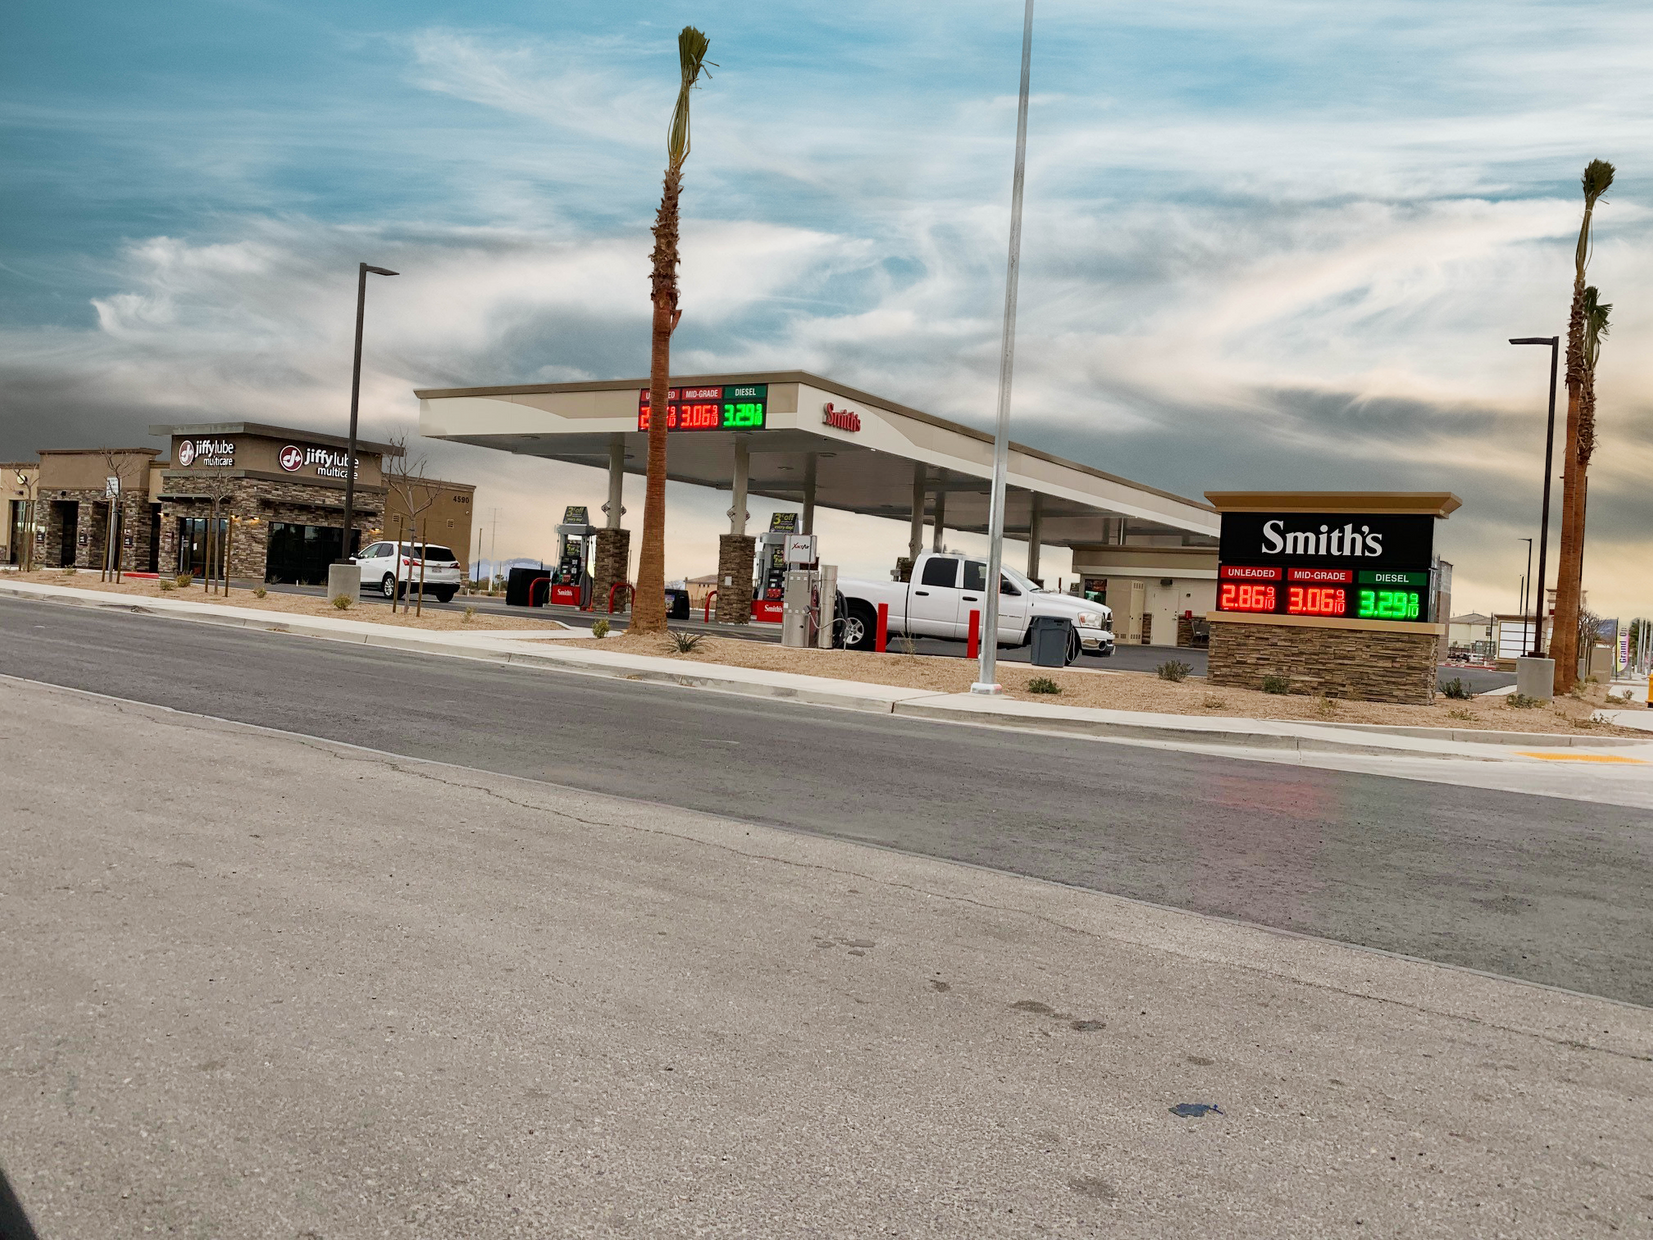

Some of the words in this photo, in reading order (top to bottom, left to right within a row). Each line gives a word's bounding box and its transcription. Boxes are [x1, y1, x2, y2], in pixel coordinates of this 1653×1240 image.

[686, 389, 718, 398] MID-GRADE
[734, 388, 757, 397] DIESEL
[823, 402, 861, 432] Smith's
[203, 456, 233, 466] multicare
[317, 467, 358, 479] multicae
[453, 496, 470, 504] 4590
[1261, 520, 1383, 557] Smith's
[1228, 569, 1275, 578] UNLEADED
[1294, 571, 1346, 581] MID-GRADE
[1375, 574, 1410, 583] DIESEL
[1619, 640, 1627, 664] Grand
